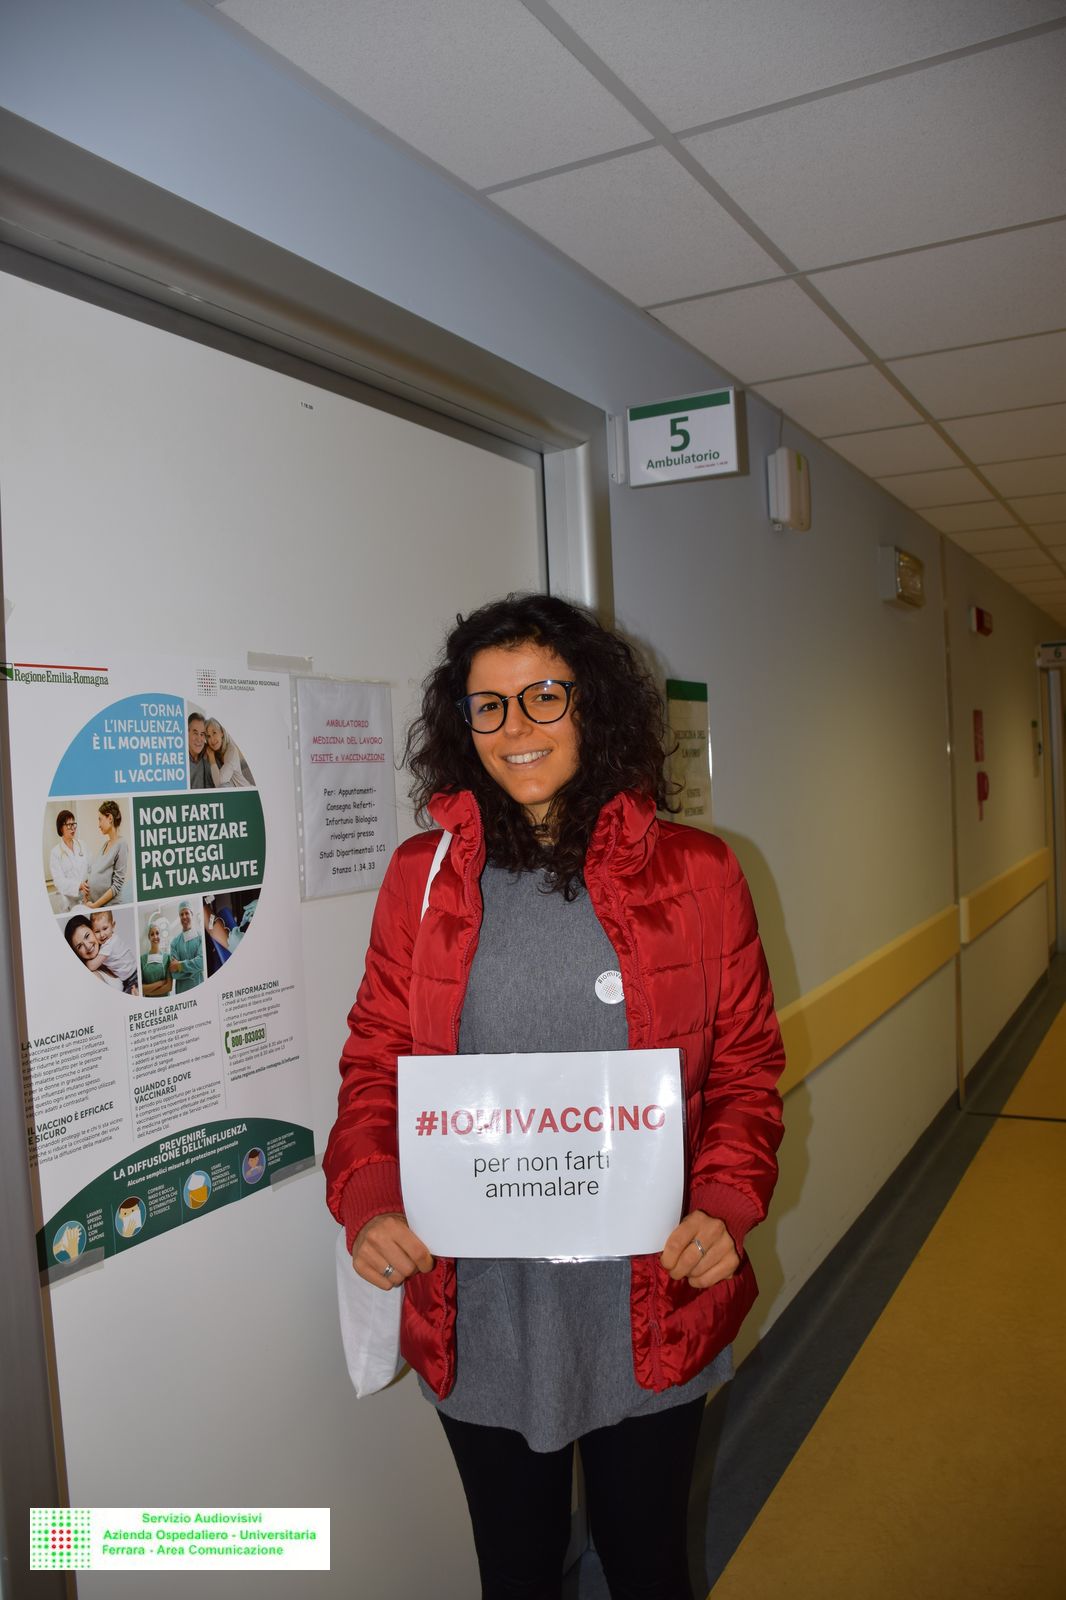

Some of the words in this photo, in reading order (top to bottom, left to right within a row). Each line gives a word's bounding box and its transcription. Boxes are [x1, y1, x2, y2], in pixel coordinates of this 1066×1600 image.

[670, 416, 690, 452] 5
[647, 450, 720, 469] Ambulatorio
[140, 703, 182, 717] TORNA
[104, 719, 183, 734] L'INFLUENZA,
[326, 720, 369, 728] AMBULATORIO
[93, 733, 100, 750] È
[104, 737, 116, 750] IL
[118, 736, 183, 749] MOMENTO
[312, 736, 344, 744] MEDICINA
[359, 736, 383, 744] LAVORO
[140, 753, 152, 766] DI
[156, 752, 184, 765] FARE
[311, 754, 334, 762] VISITE
[341, 753, 385, 762] VACCINAZIONI
[115, 770, 126, 784] IL
[130, 768, 184, 782] VACCINO
[324, 789, 335, 797] Per:
[338, 788, 376, 797] Appuntamenti-
[139, 806, 177, 826] NON
[181, 803, 224, 822] FARTI
[326, 803, 351, 812] Consegna
[326, 818, 354, 826] Infortunio
[355, 816, 377, 826] Biologico
[140, 821, 248, 847] INFLUENZARE
[330, 832, 355, 841] rivolgersi
[357, 832, 374, 841] presso
[142, 844, 224, 869] PROTEGGI
[320, 850, 334, 859] Studi
[336, 846, 374, 858] Dipartimentali
[142, 871, 162, 891] LA
[166, 867, 199, 886] TUA
[202, 859, 258, 882] SALUTE
[332, 866, 352, 875] Stanza
[222, 991, 233, 1000] PER
[235, 980, 279, 997] INFORMAZIONI
[129, 1013, 142, 1022] PER
[144, 1009, 157, 1018] CHI
[164, 1000, 198, 1014] GRATUITA
[130, 1023, 134, 1031] E
[136, 1013, 178, 1030] NECESSARIA
[21, 1041, 32, 1051] LA
[34, 1026, 94, 1047] VACCINAZIONE
[134, 1080, 166, 1095] QUANDO
[173, 1072, 191, 1083] DOVE
[135, 1085, 176, 1104] VACCINARSI
[37, 1115, 72, 1133] VACCINO
[74, 1110, 79, 1120] È
[80, 1101, 113, 1119] EFFICACE
[35, 1127, 67, 1143] SICURO
[160, 1128, 206, 1153] PREVENIRE
[113, 1168, 126, 1181] LA
[127, 1148, 180, 1176] DIFFUSIONE
[182, 1123, 248, 1155] DELL'INFLUENZA
[127, 1176, 145, 1187] Alcune
[146, 1168, 167, 1180] semplici
[168, 1161, 185, 1171] misure
[190, 1149, 216, 1164] protezione
[216, 1141, 238, 1154] personale
[474, 1157, 510, 1177] per
[517, 1156, 558, 1172] non
[565, 1151, 610, 1170] farti
[486, 1177, 599, 1198] ammalare
